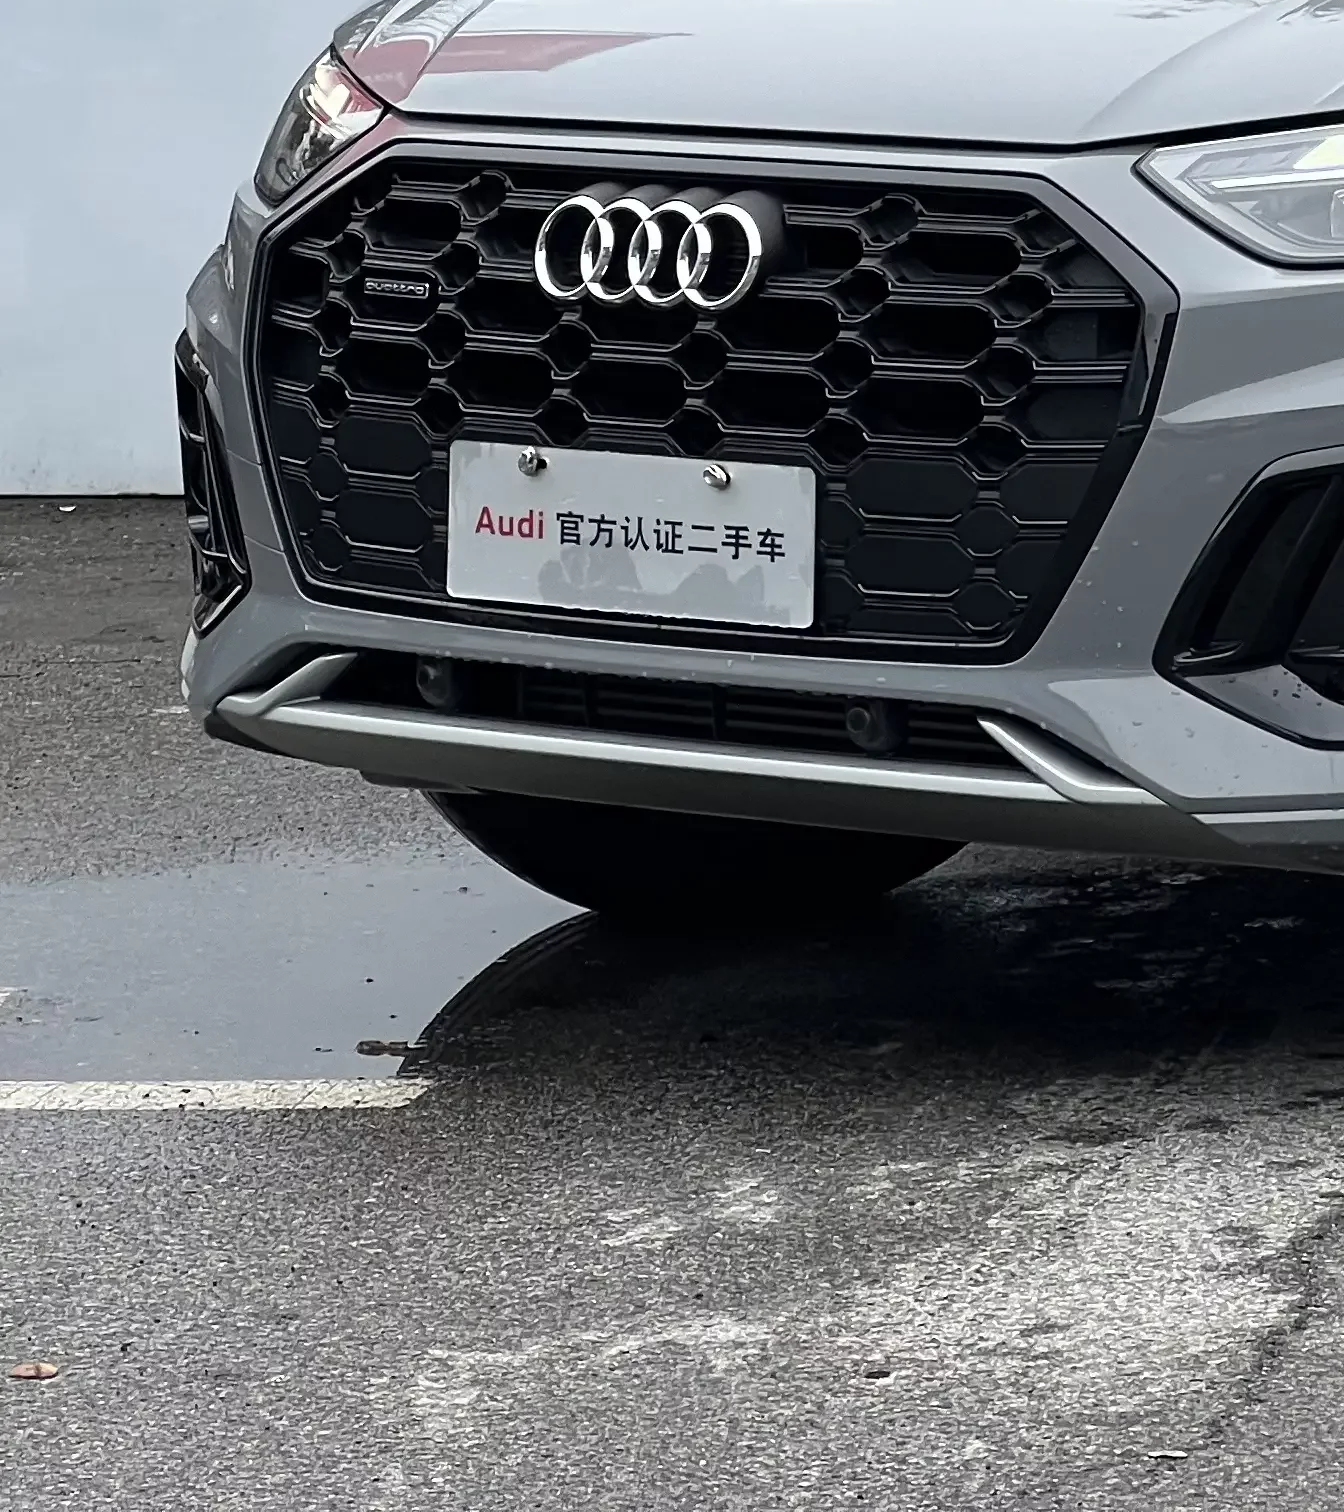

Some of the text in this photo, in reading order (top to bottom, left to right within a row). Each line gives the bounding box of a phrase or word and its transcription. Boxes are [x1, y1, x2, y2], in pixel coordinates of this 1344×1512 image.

[475, 506, 787, 563] Audi 官方认证二手车
